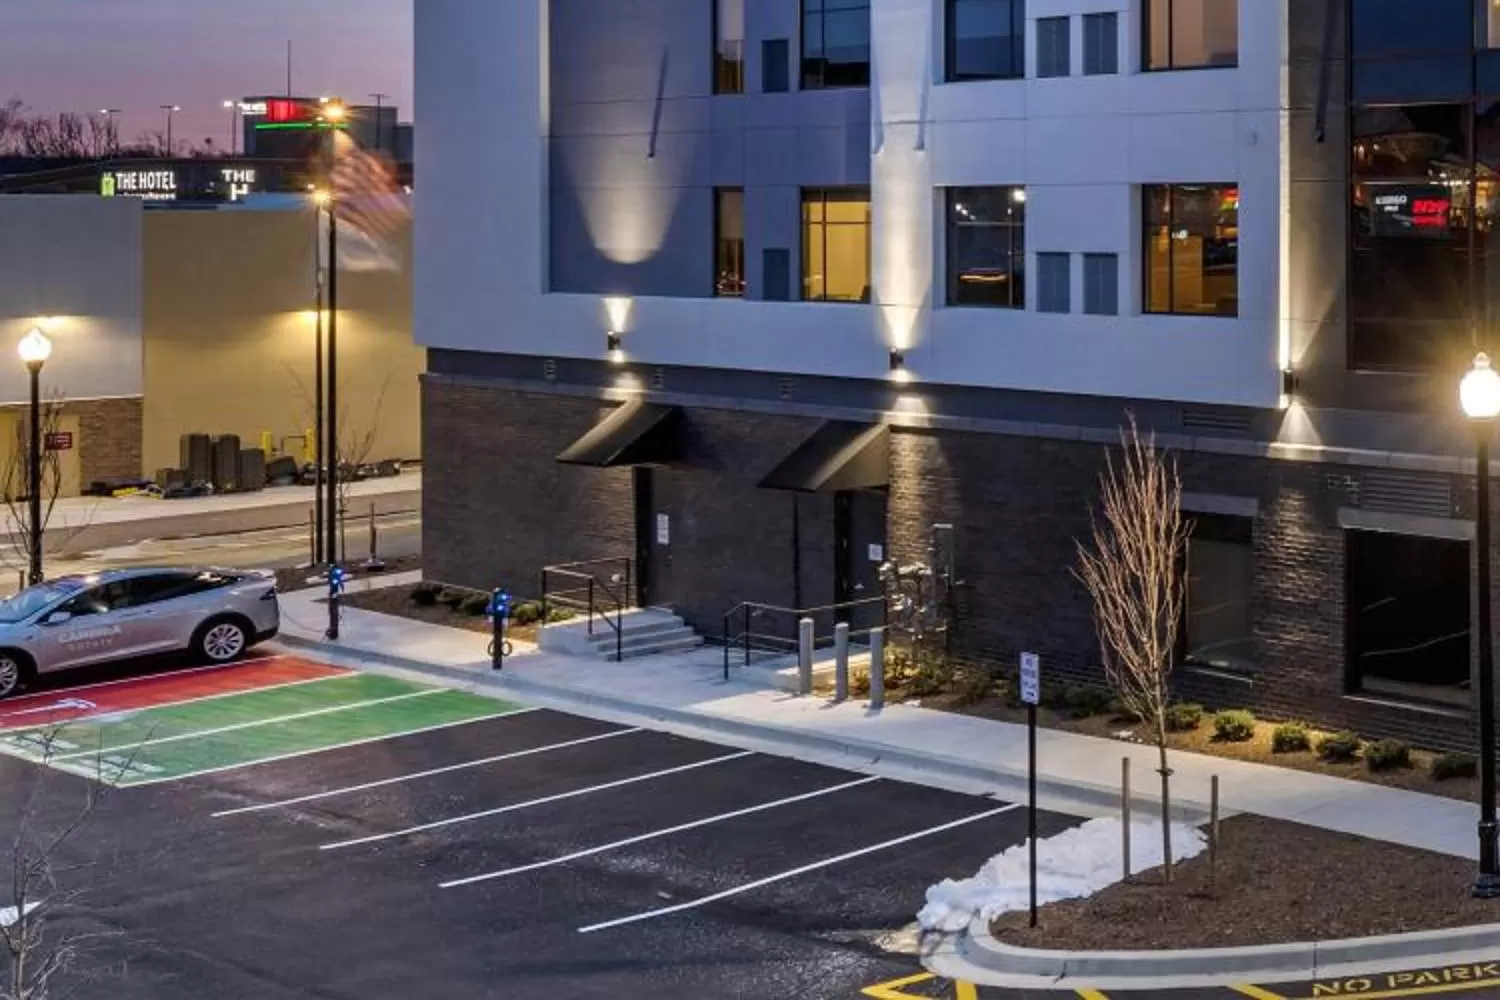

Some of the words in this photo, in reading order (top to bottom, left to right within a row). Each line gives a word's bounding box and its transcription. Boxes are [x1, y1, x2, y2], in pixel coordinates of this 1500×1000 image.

[115, 172, 136, 190] THE
[139, 171, 176, 190] HOTEL
[222, 169, 255, 182] THE
[1312, 978, 1370, 997] NO
